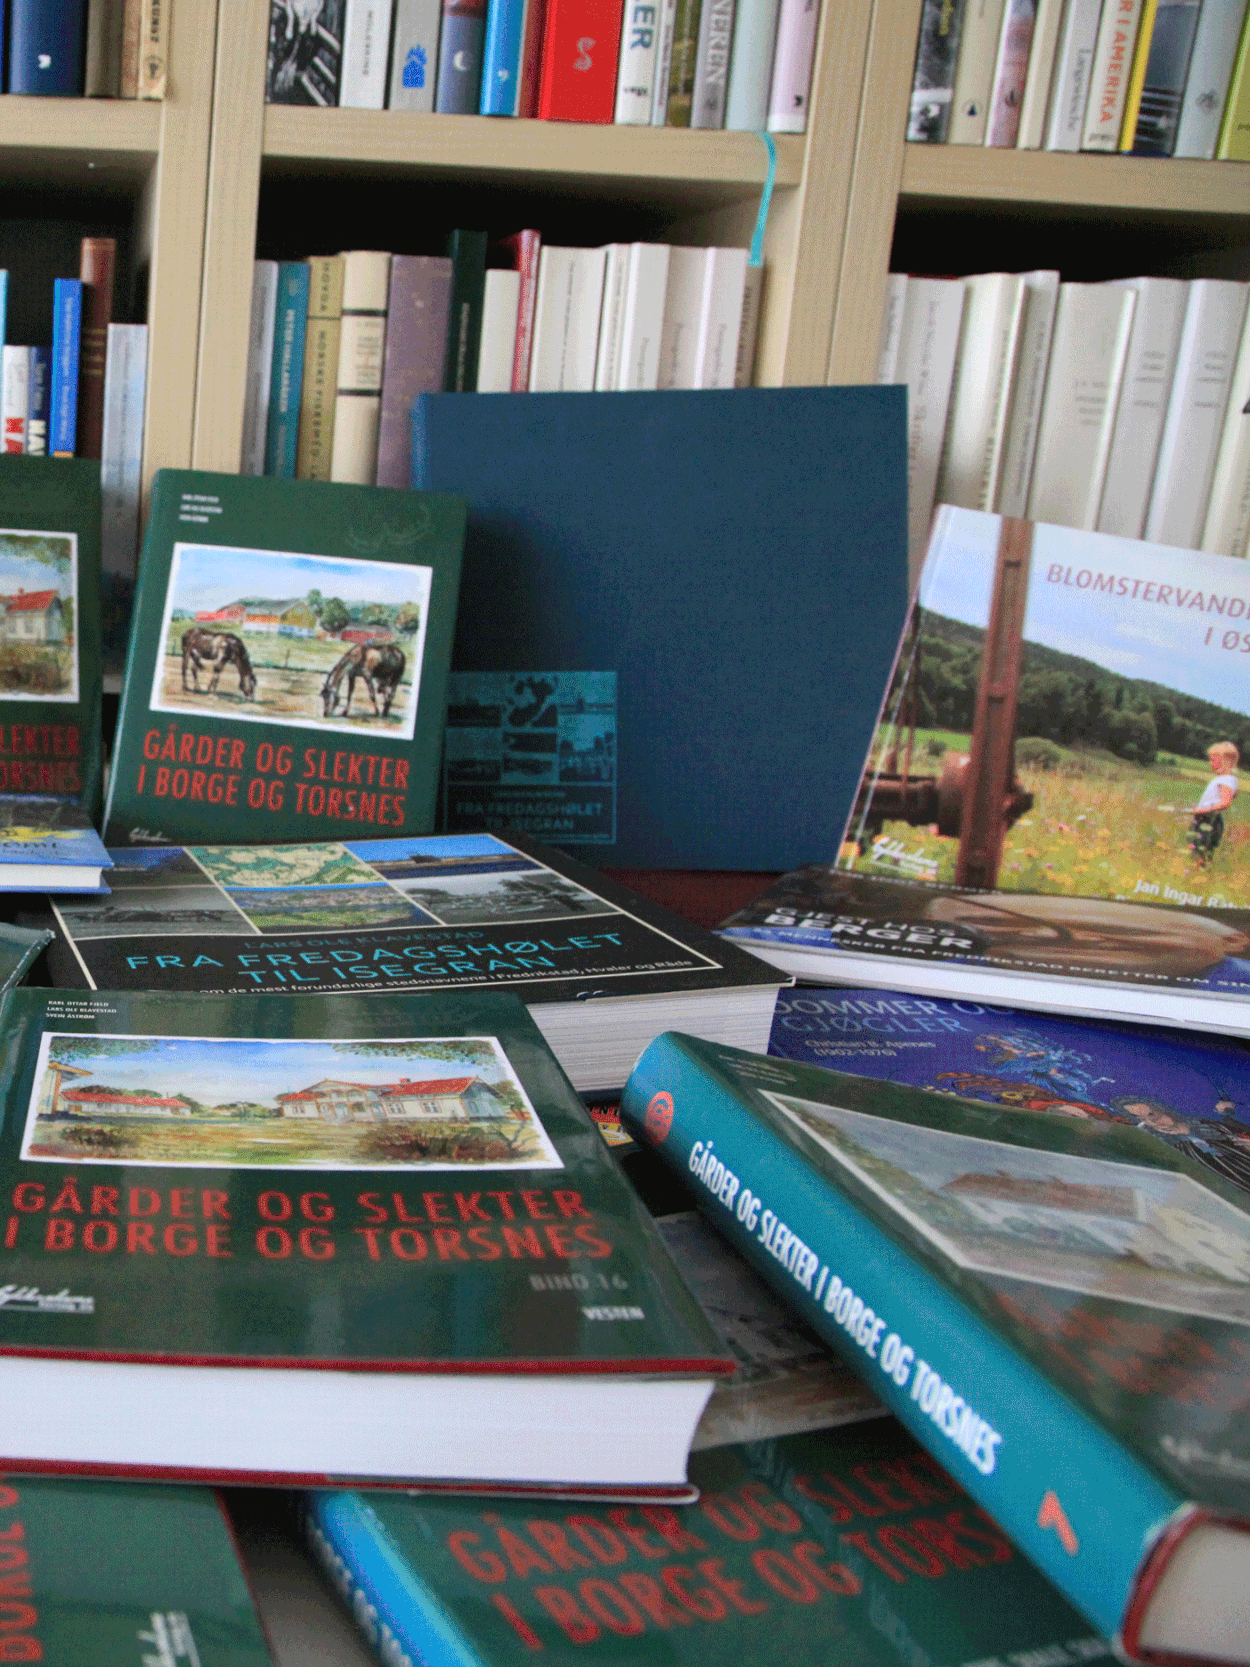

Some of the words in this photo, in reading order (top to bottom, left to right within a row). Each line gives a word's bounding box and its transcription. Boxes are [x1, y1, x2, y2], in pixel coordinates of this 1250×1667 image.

[1099, 31, 1128, 123] AMERIKA
[1204, 626, 1212, 646] I
[143, 723, 247, 770] GÅRDER
[255, 743, 294, 775] OG
[302, 748, 411, 791] SLEKTER
[136, 764, 146, 795] I
[154, 766, 240, 807] BORGE
[247, 778, 284, 811] OG
[295, 783, 407, 827] TORSNES
[1133, 879, 1160, 896] Jan
[1163, 885, 1204, 906] Ingar
[356, 931, 485, 944] KLAVESTAD
[764, 913, 974, 950] BERGER
[776, 907, 876, 926] GJEST
[884, 921, 956, 937] HOS
[125, 954, 224, 969] FRA
[237, 932, 623, 967] FREDAGSHØLET
[932, 950, 1064, 970] FREDRIKSTAD
[1070, 965, 1170, 981] BERETTER
[1176, 976, 1210, 984] OM
[228, 986, 248, 994] de
[249, 984, 289, 994] mest
[290, 980, 384, 993] forunderlige
[386, 975, 488, 987] stedsnavnene
[496, 966, 586, 981] Fredrikstad,
[588, 963, 633, 975] Hvaler
[635, 963, 655, 972] og
[238, 970, 320, 983] TIL
[332, 955, 556, 980] ISEGRAN
[774, 999, 943, 1015] DOMMER
[781, 1016, 973, 1033] GJØGLER
[805, 1039, 866, 1049] Christian
[11, 1174, 234, 1220] GÅRDER
[256, 1191, 336, 1222] OG
[356, 1190, 593, 1226] SLEKTER
[3, 1219, 18, 1249] I
[43, 1220, 235, 1258] BORGE
[254, 1226, 336, 1261] OG
[353, 1226, 613, 1263] TORSNES
[689, 1141, 740, 1211] GÅRDER
[736, 1188, 762, 1232] OG
[758, 1209, 820, 1292] SLEKTER
[814, 1265, 830, 1301] I
[823, 1275, 888, 1360] BORGE
[880, 1333, 916, 1386] OG
[911, 1359, 1003, 1475] TORSNES
[446, 1504, 709, 1584] GÅRDER
[699, 1483, 802, 1542] OG
[491, 1592, 544, 1652] I
[534, 1557, 769, 1646] BORGE
[752, 1540, 863, 1605] OG
